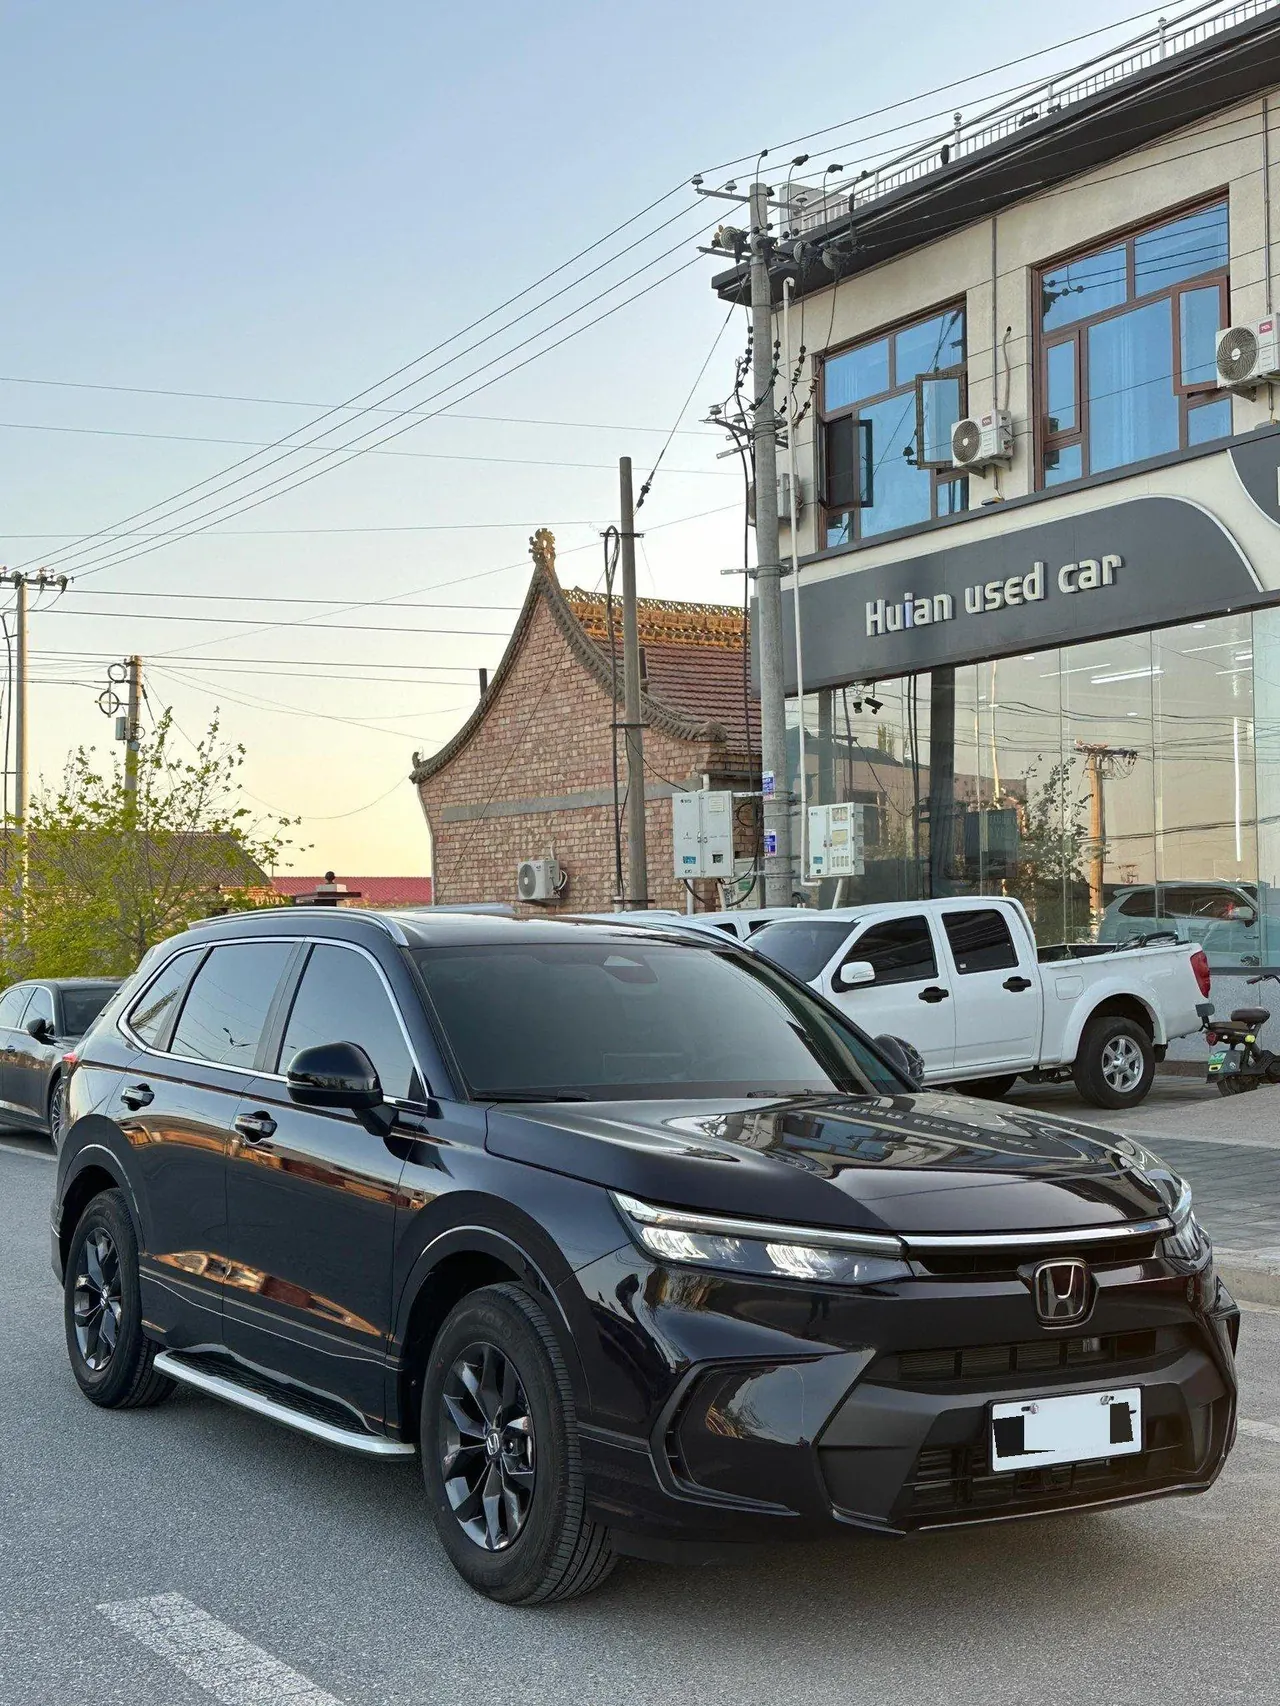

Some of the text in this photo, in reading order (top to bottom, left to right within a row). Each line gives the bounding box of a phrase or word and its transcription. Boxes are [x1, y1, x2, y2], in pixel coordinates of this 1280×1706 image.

[866, 554, 1122, 637] Huian used car
